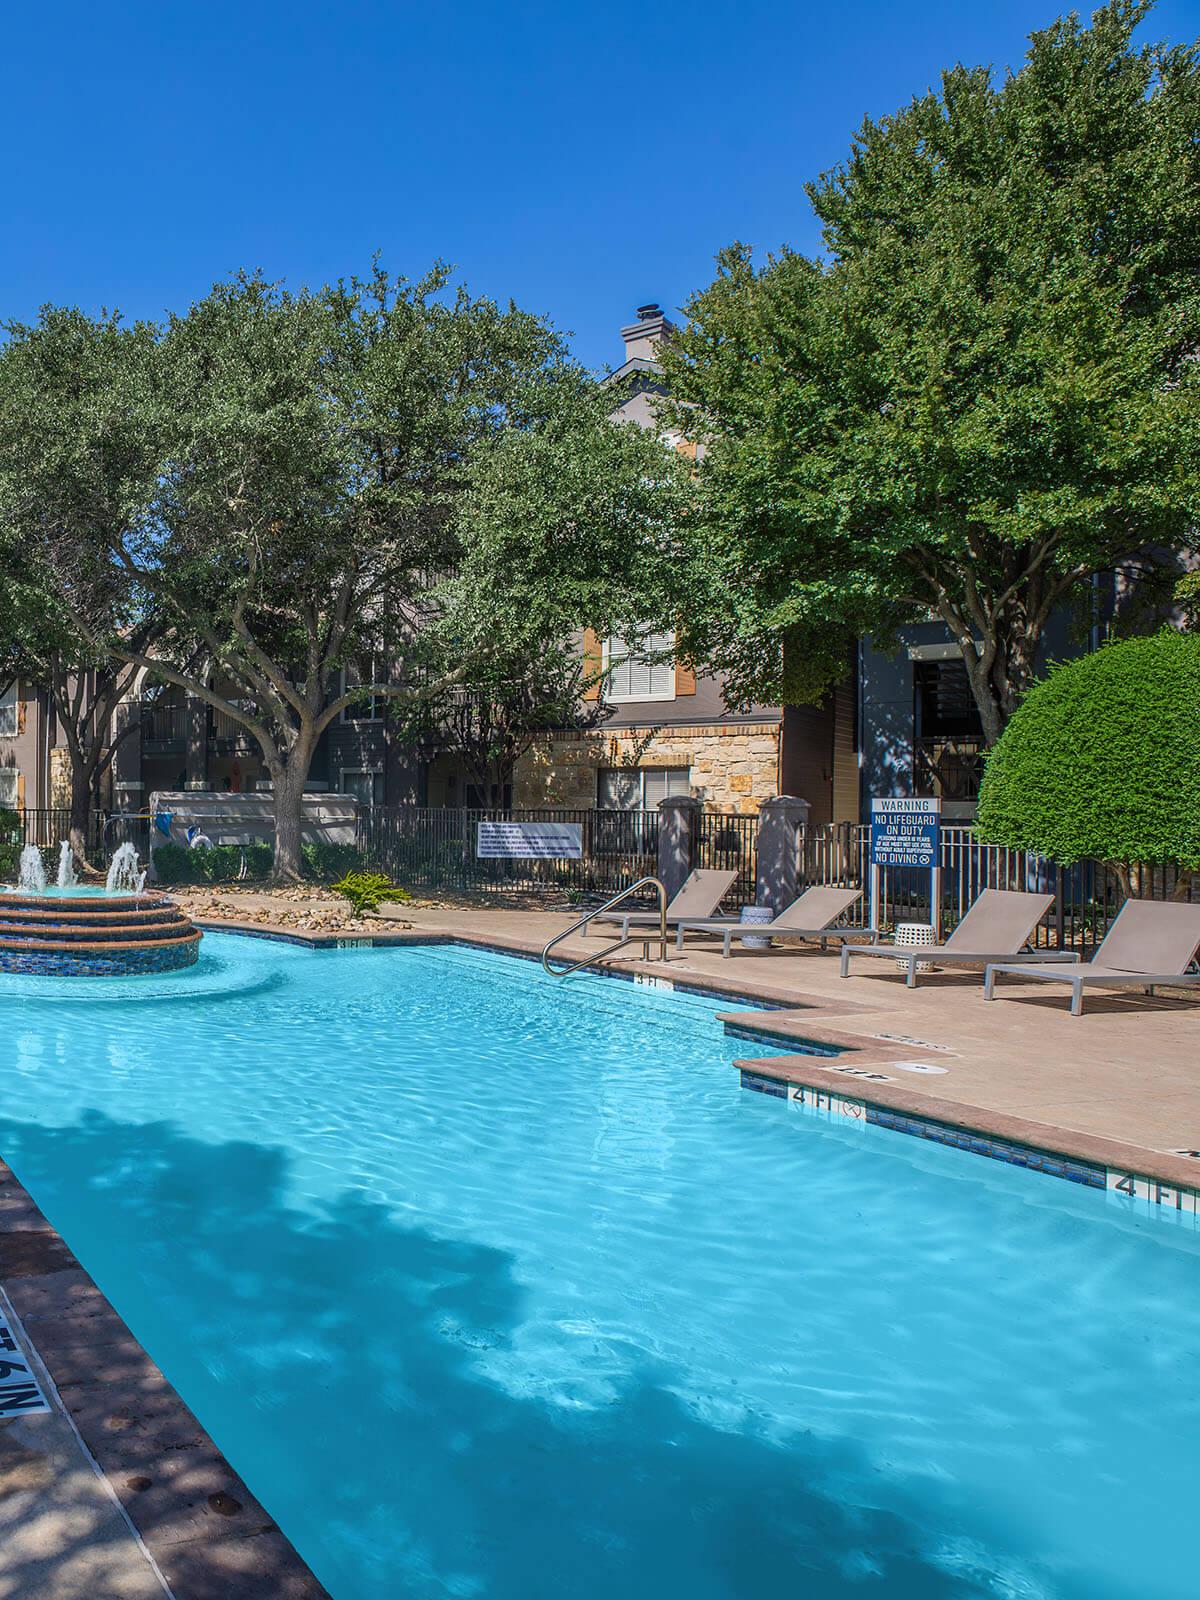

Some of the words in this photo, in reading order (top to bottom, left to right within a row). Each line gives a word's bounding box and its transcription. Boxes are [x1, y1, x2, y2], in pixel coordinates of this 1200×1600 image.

[882, 801, 929, 811] WARNING
[875, 815, 887, 825] NO
[889, 815, 936, 825] LIFEGUARD
[887, 825, 898, 835] ON
[901, 826, 923, 835] DUTY
[875, 853, 888, 863] NO
[889, 853, 918, 864] DIVING
[340, 939, 346, 948] 3
[637, 974, 643, 984] 3
[648, 975, 658, 987] FT
[792, 1087, 806, 1104] 4
[815, 1090, 832, 1111] FT
[1115, 1173, 1137, 1198] 4
[1155, 1181, 1188, 1211] FT
